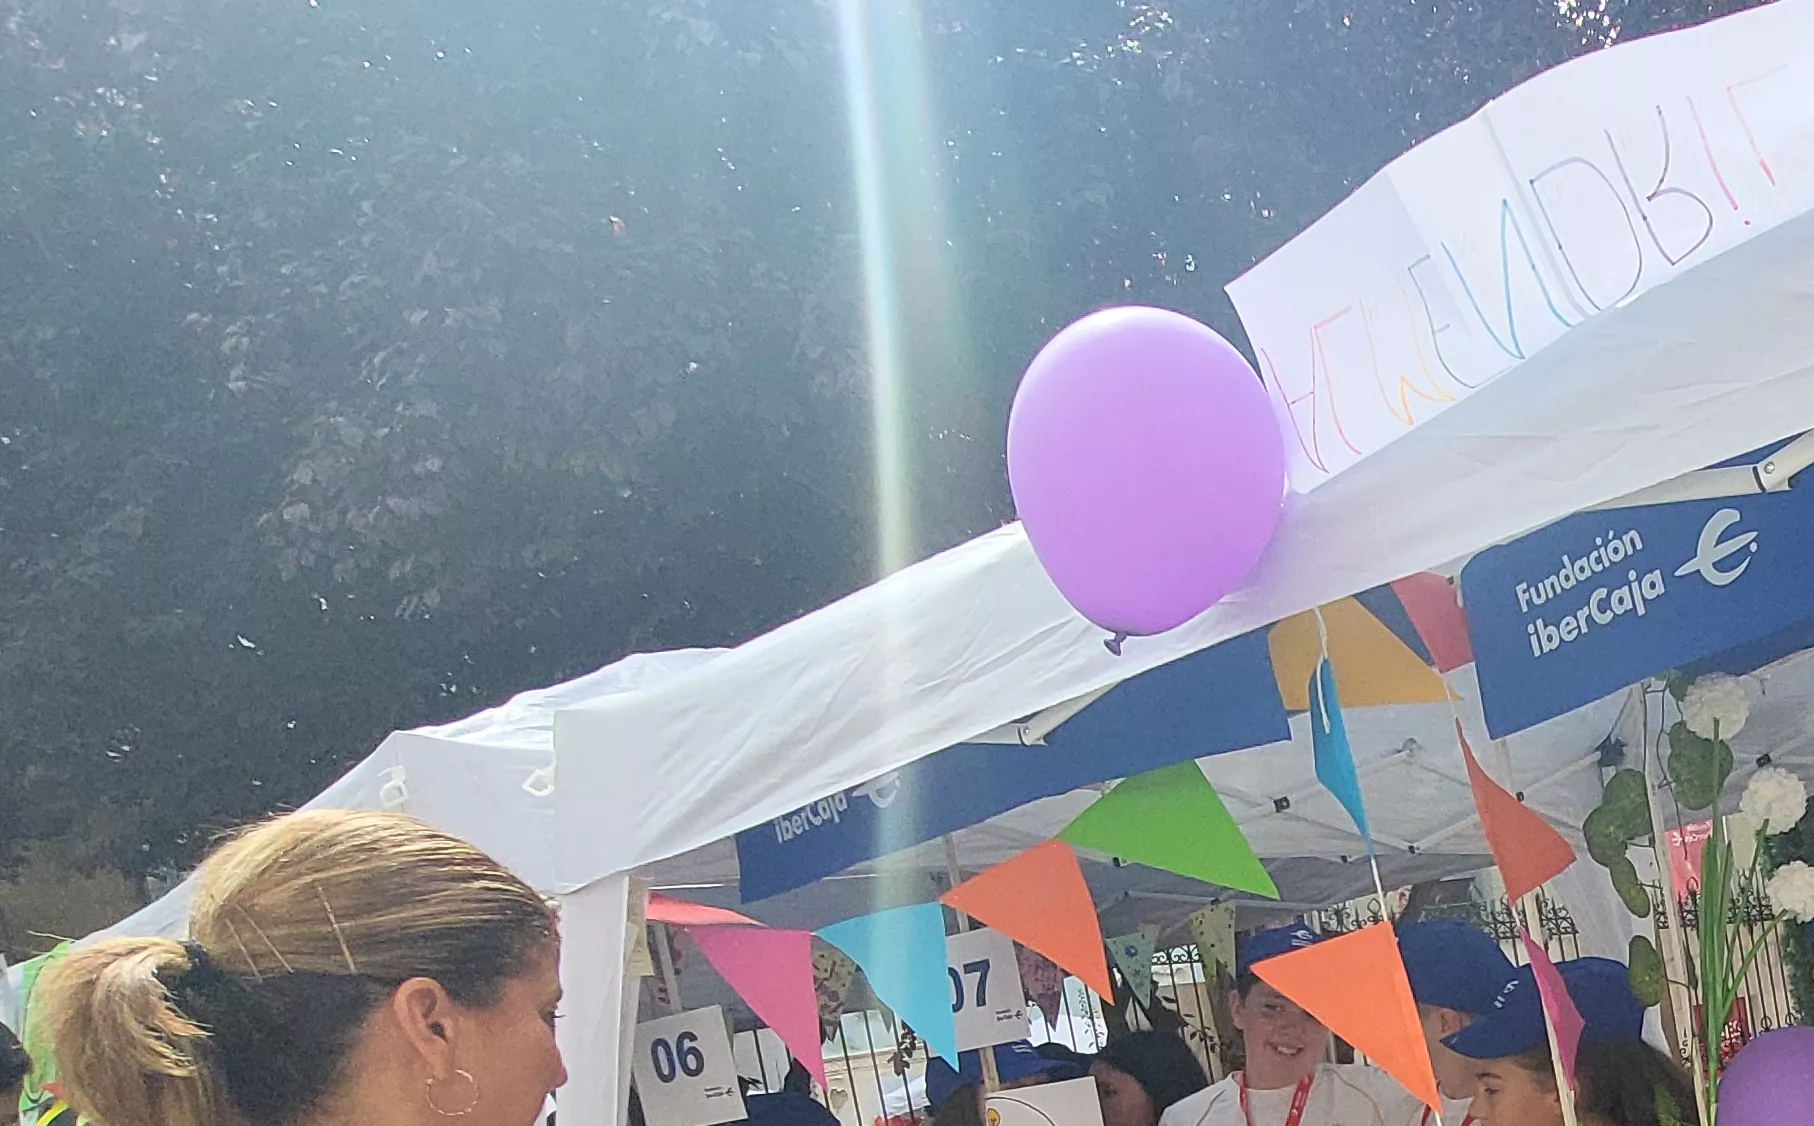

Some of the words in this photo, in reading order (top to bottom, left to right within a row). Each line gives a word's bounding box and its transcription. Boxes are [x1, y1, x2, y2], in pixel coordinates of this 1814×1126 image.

[1515, 530, 1644, 613] Fundación
[1527, 569, 1666, 658] iberCaja
[651, 1031, 705, 1083] 06
